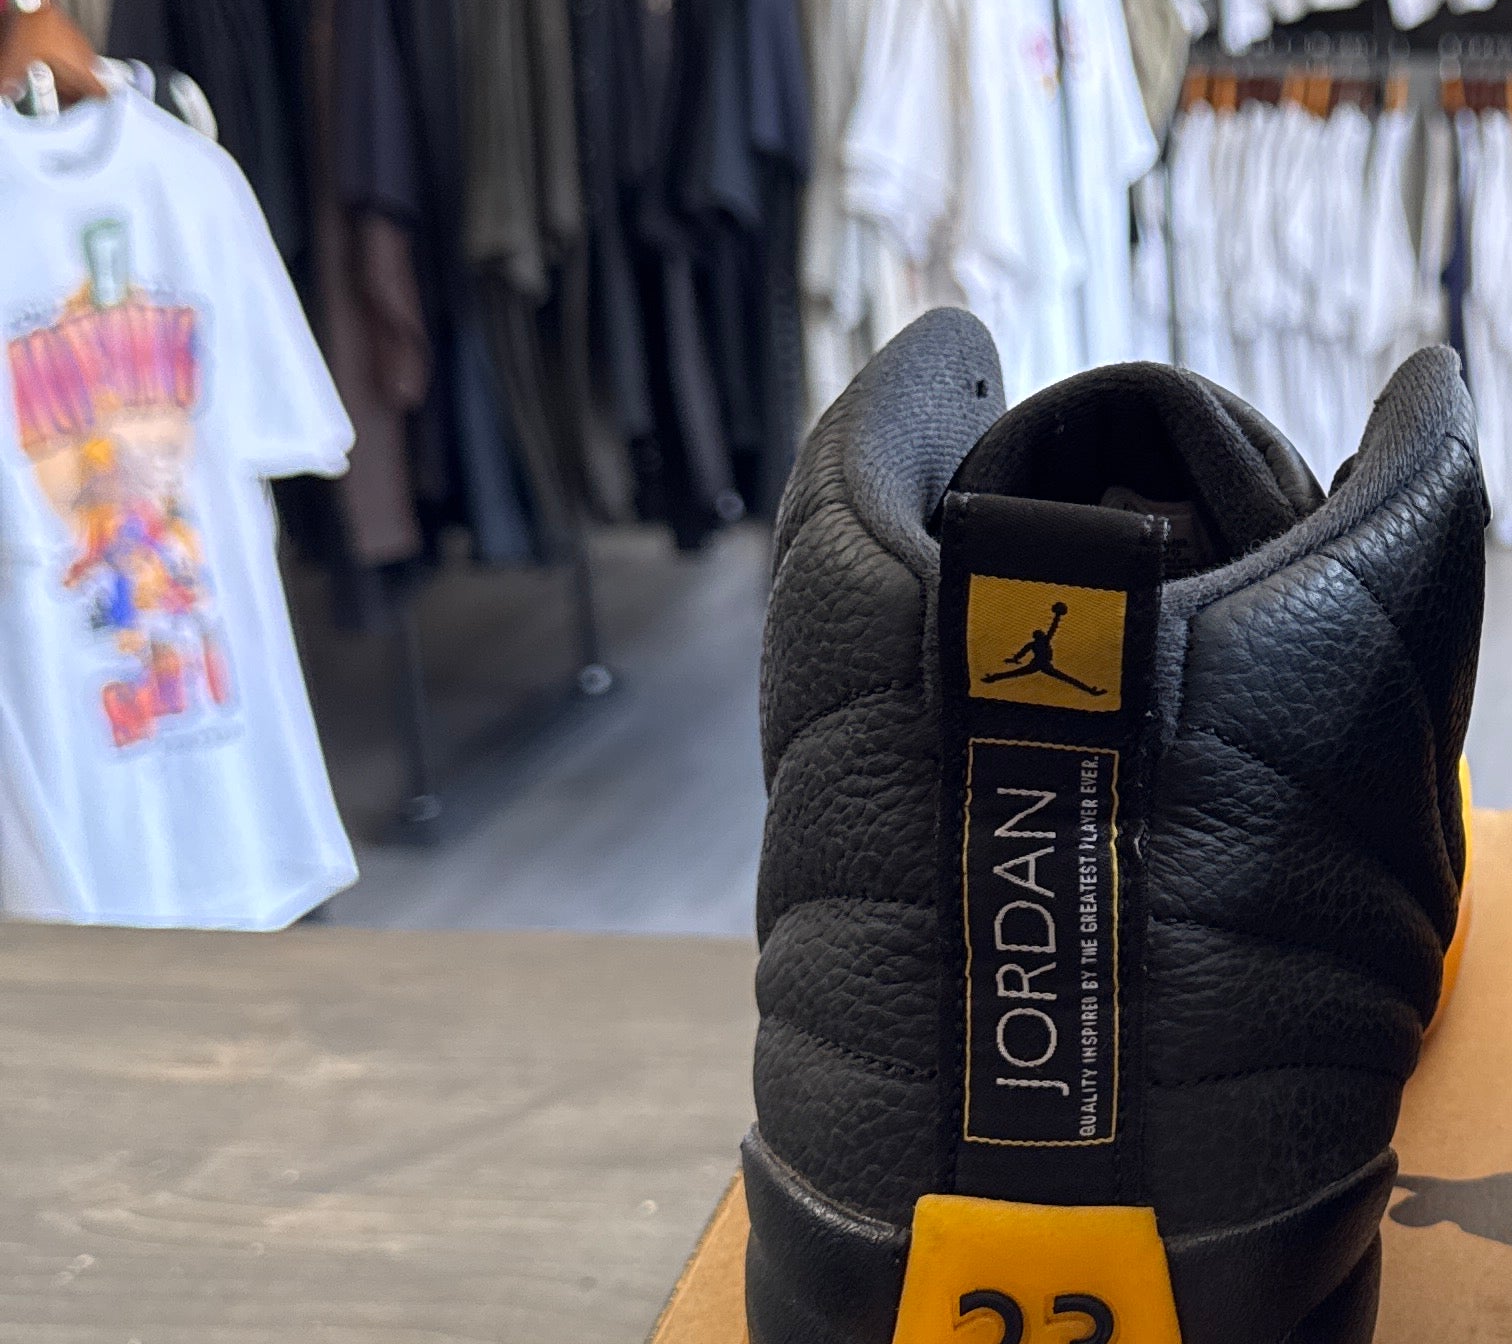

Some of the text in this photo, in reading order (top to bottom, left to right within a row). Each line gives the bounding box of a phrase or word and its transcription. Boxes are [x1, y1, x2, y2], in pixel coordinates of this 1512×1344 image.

[992, 786, 1070, 1097] JORDAN
[1079, 755, 1100, 1137] QUALITY INSPIRED BY THE GREATEST PLAYER EVER.
